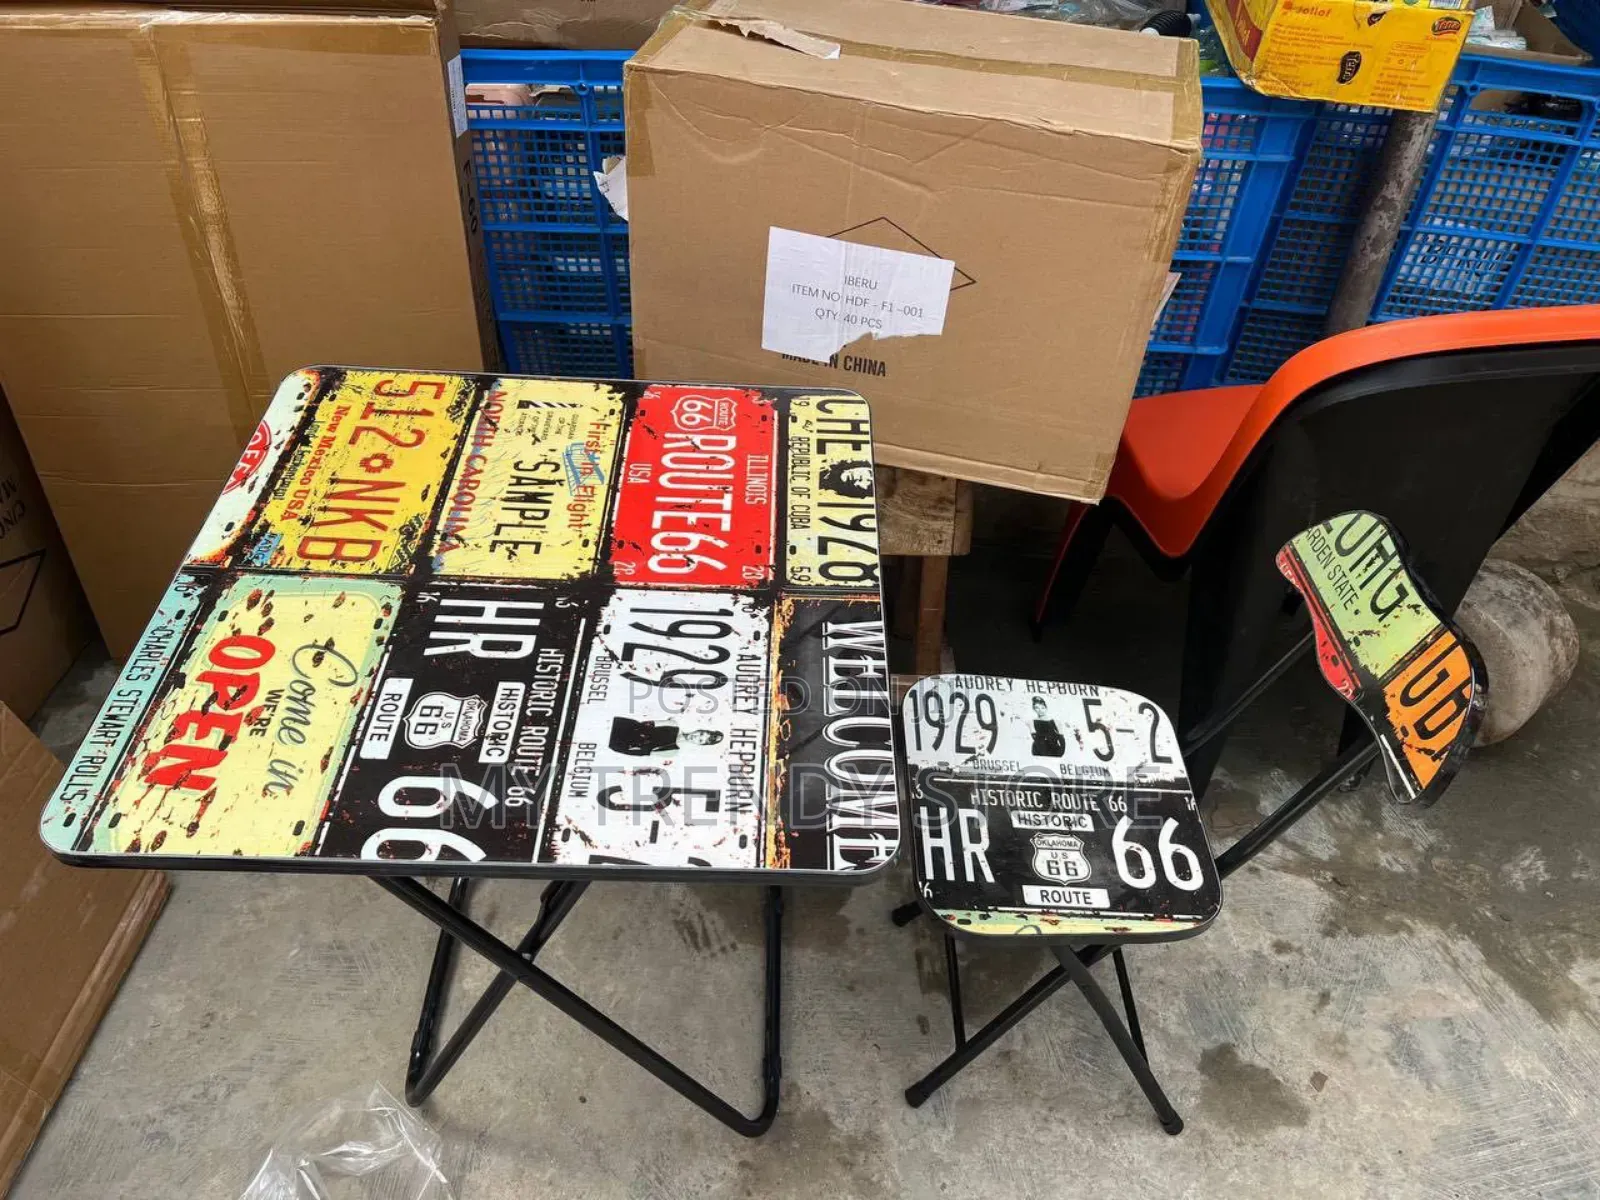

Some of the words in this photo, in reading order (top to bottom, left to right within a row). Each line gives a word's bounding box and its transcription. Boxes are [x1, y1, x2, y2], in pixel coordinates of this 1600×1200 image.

[792, 283, 820, 299] ITEM
[845, 294, 870, 308] HDF
[844, 274, 878, 290] IBERU
[843, 312, 858, 325] 40
[860, 315, 883, 329] PCS
[843, 355, 886, 377] CHINA
[329, 405, 351, 434] New
[349, 379, 446, 448] 512
[471, 391, 508, 447] NORTH
[680, 399, 713, 427] 66
[718, 402, 729, 426] ROUTE
[298, 435, 338, 487] Mexico
[628, 463, 653, 485] USA
[745, 454, 769, 505] ILLINOIS
[280, 489, 311, 522] USA
[435, 454, 488, 553] CAROLINA
[489, 459, 561, 555] SAMPLE
[790, 486, 811, 500] OF
[790, 504, 811, 530] CUBA
[296, 478, 407, 562] NKB
[1327, 563, 1360, 611] STATE
[125, 627, 175, 682] CHARLES
[423, 600, 544, 659] HR
[619, 607, 734, 690] 1929
[276, 643, 358, 746] Come
[525, 648, 565, 717] HISTORIC
[587, 654, 613, 705] BRUSSEL
[732, 653, 761, 716] AUDREY
[954, 675, 1014, 692] AUDREY
[89, 688, 143, 748] STEWART
[143, 634, 277, 792] OPEN
[249, 688, 285, 738] WE'RE
[369, 693, 401, 743] ROUTE
[413, 705, 445, 735] 66
[456, 701, 478, 742] OKLAHOMA
[485, 687, 521, 758] HISTORIC
[908, 689, 998, 756] 1929
[1082, 698, 1172, 763] 5-2
[509, 725, 550, 777] ROUTE
[568, 742, 597, 798] BELGIUM
[822, 620, 899, 870] WELCOME
[59, 754, 107, 802] ROLLS
[503, 785, 535, 808] 66
[724, 728, 757, 815] HEPBURN
[360, 776, 499, 863] 66
[970, 788, 1043, 808] HISTORIC
[1051, 793, 1100, 811] ROUTE
[1108, 795, 1128, 812] 66
[1017, 815, 1089, 829] HISTORIC
[920, 806, 996, 883] HR
[1111, 815, 1205, 892] 66
[1035, 838, 1078, 849] OKLAHOMA
[1046, 860, 1079, 878] 66
[1039, 889, 1094, 905] ROUTE
